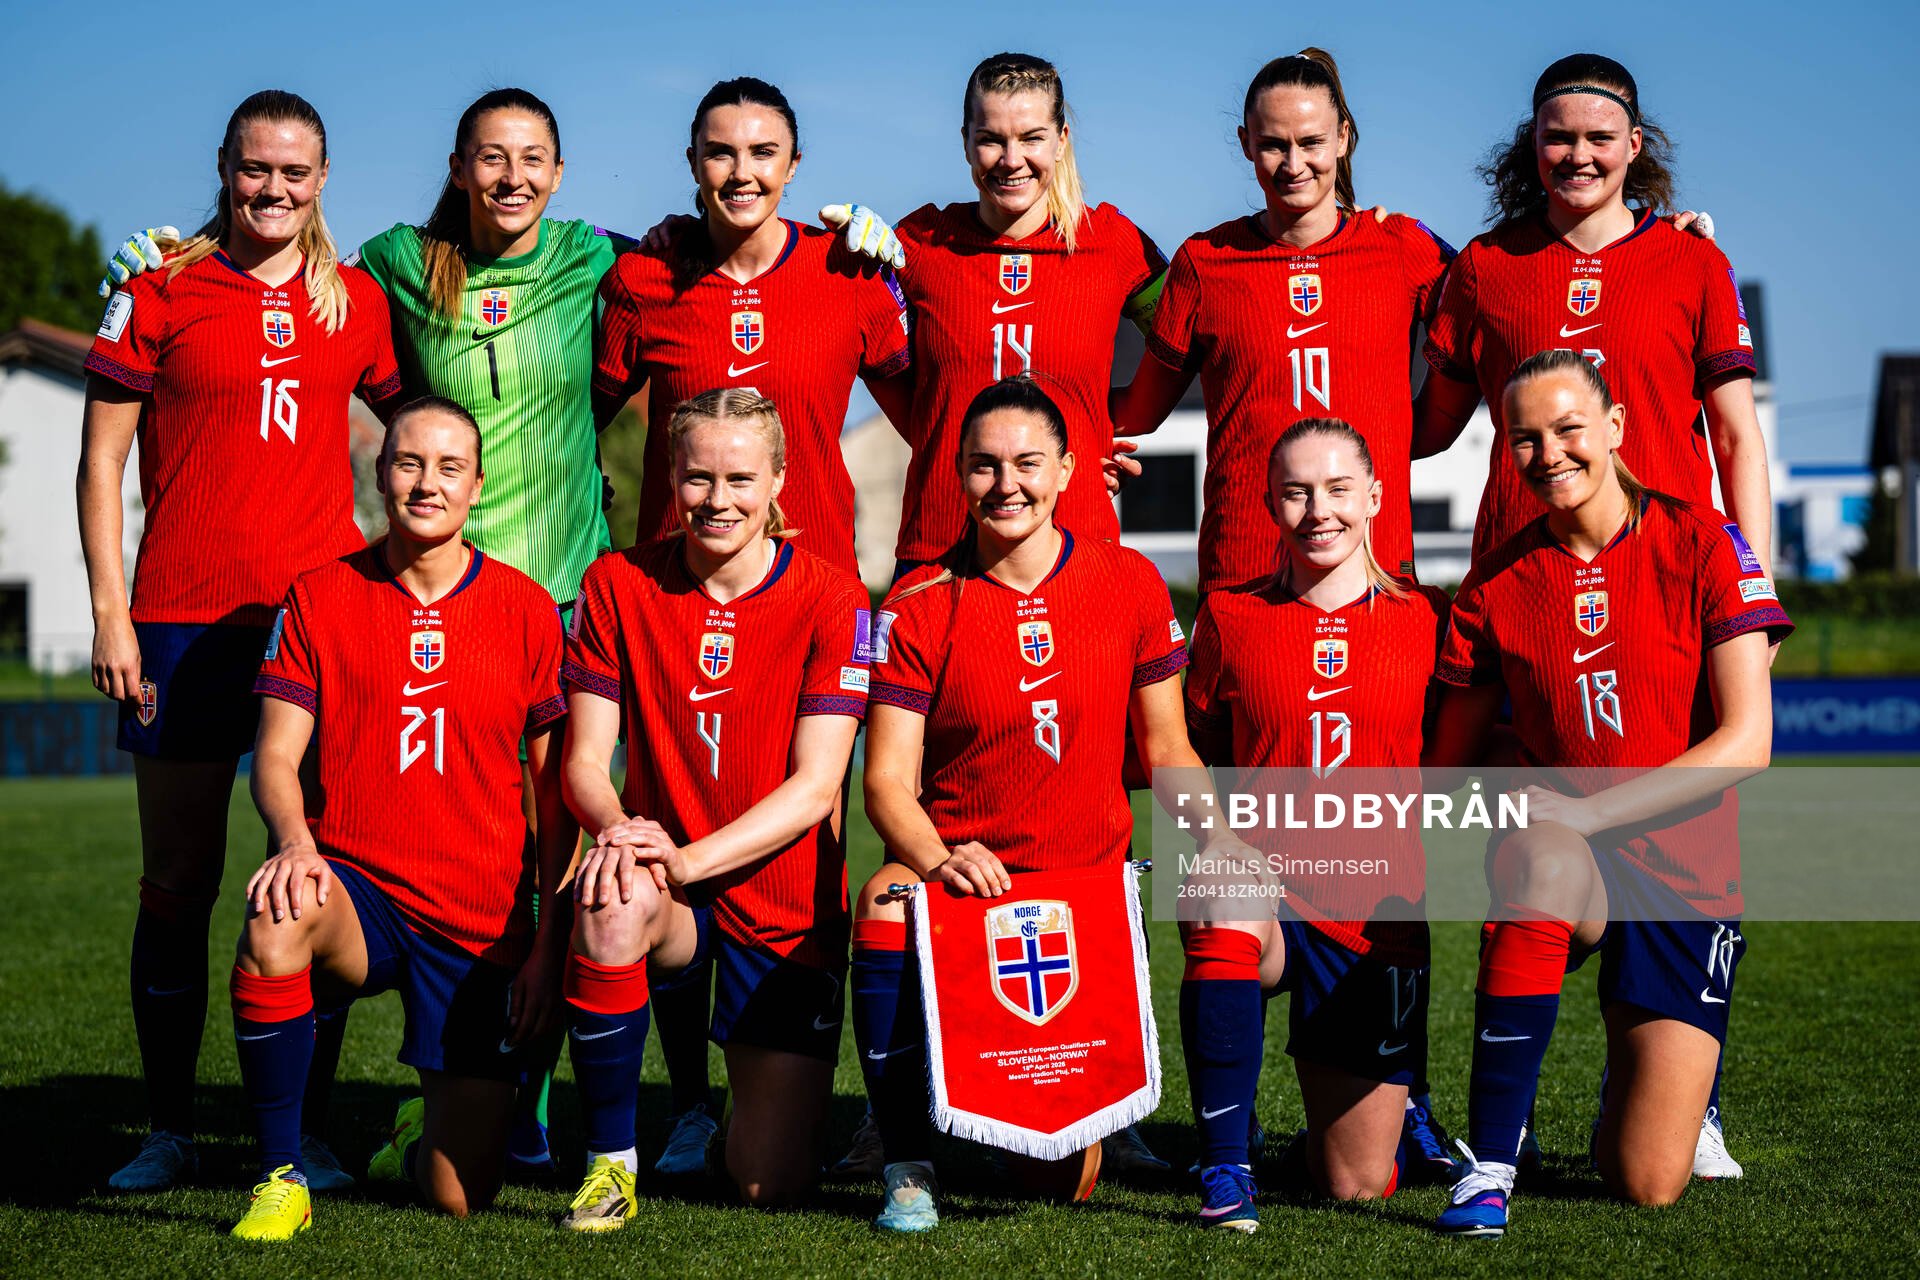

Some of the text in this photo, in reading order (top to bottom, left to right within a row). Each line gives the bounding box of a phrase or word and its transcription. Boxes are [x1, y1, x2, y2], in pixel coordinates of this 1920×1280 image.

[483, 341, 501, 402] 1
[990, 323, 1033, 382] 14
[1287, 347, 1330, 412] 10
[259, 377, 300, 445] 16
[1031, 698, 1061, 765] 8
[1574, 669, 1624, 741] 18
[400, 706, 445, 775] 21
[696, 711, 722, 781] 4
[1307, 711, 1352, 779] 13
[1014, 905, 1042, 919] NORGE
[980, 1039, 1107, 1059] UEFA Women's European Qualifiers 2026
[1030, 1070, 1054, 1078] stadion
[1070, 1066, 1084, 1074] Ptuj
[1034, 1063, 1050, 1071] April
[1051, 1061, 1066, 1069] 2026
[1033, 1077, 1061, 1086] Slovenia
